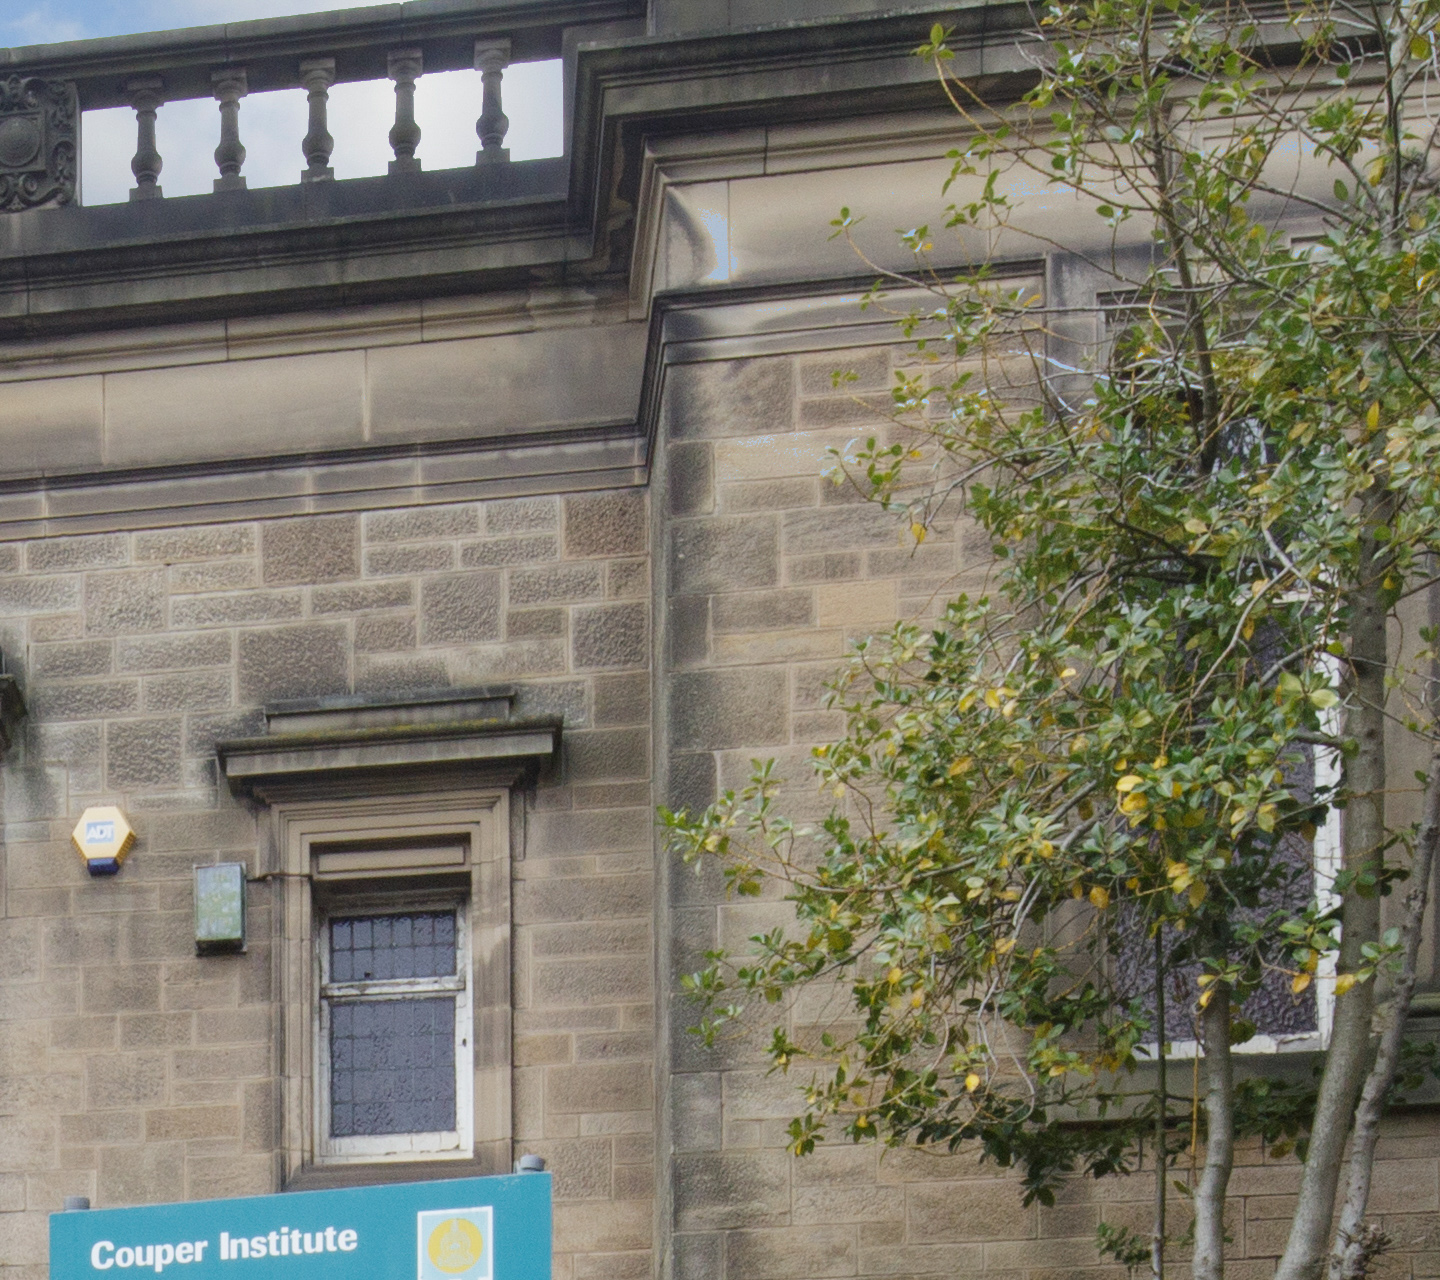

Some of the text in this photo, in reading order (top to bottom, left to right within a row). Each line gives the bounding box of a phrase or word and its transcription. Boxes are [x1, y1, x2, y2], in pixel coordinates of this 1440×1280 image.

[86, 825, 115, 839] ADT
[90, 1226, 358, 1272] Couper Institute
